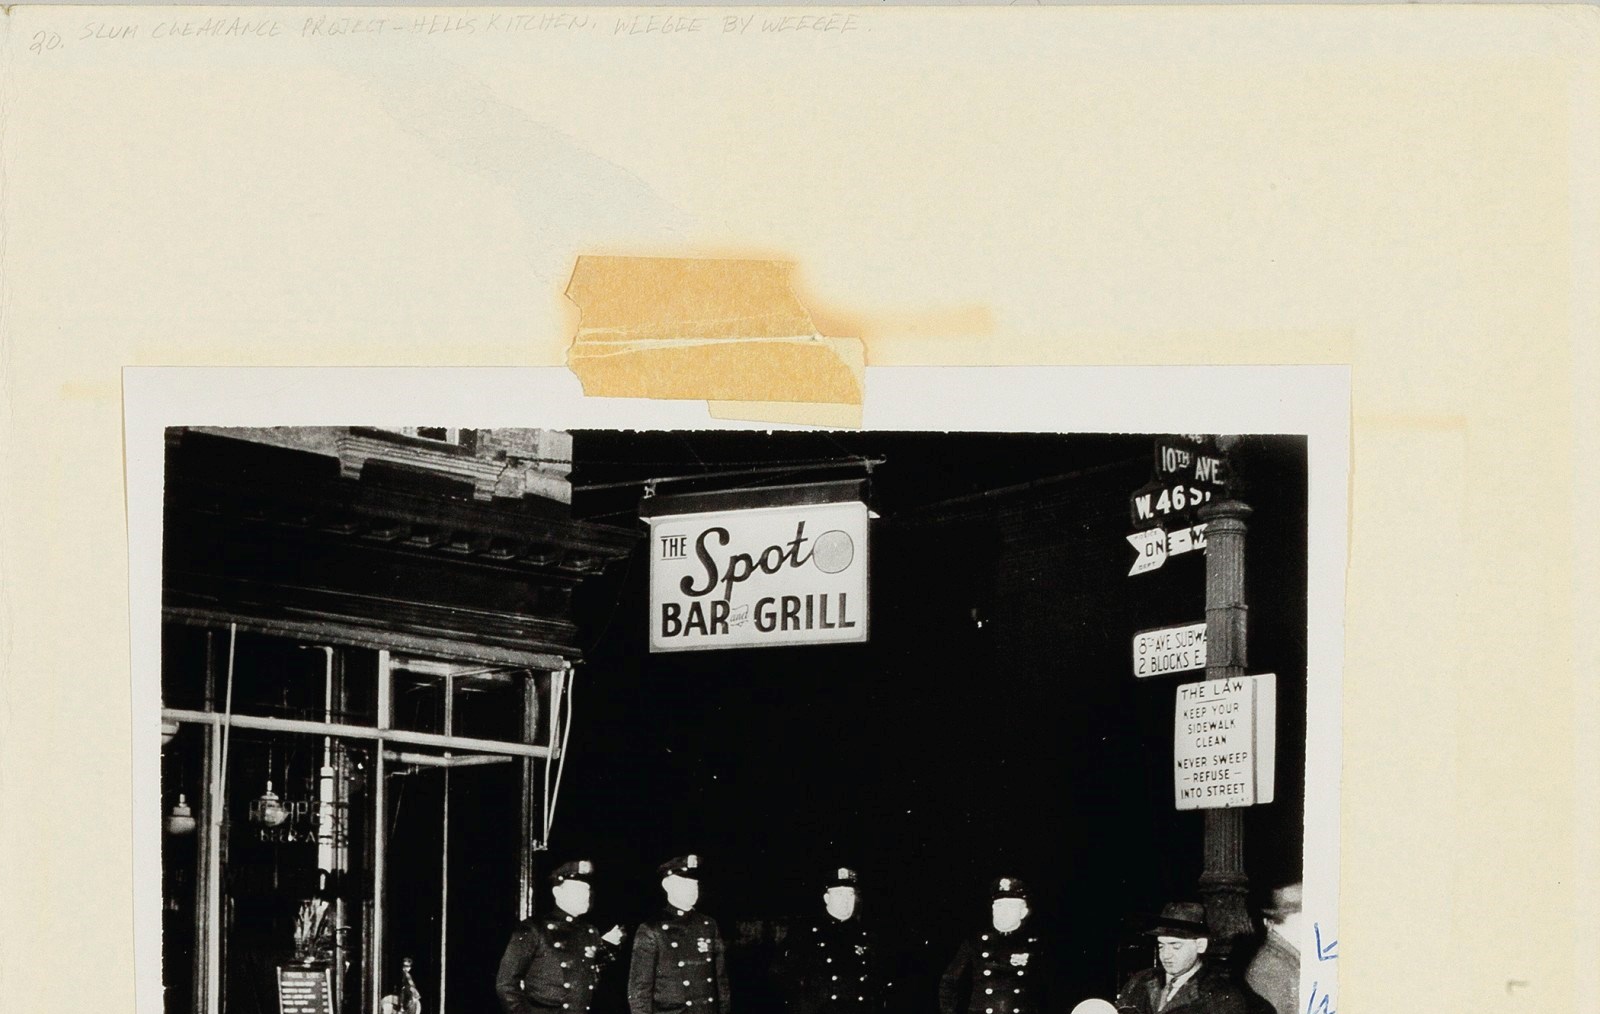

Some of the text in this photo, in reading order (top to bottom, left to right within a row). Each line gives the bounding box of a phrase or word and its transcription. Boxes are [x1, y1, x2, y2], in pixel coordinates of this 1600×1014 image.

[29, 30, 66, 55] 20.
[80, 22, 139, 40] SLUM
[614, 14, 708, 36] WEEGEE
[721, 15, 751, 36] BY
[1162, 445, 1190, 473] 10TH
[661, 521, 814, 603] THE Spot
[661, 599, 730, 638] BAR
[754, 592, 856, 633] GRILL
[1139, 658, 1146, 675] 2
[1151, 652, 1189, 673] BLOCKS
[1181, 680, 1243, 700] THE LAW
[1183, 702, 1239, 720] KEEP YOUR
[1188, 718, 1236, 735] SIDEWALK
[1196, 735, 1227, 748] CLEAN
[1177, 752, 1248, 770] NEVER SWEEP
[1181, 783, 1245, 800] INTO STREET
